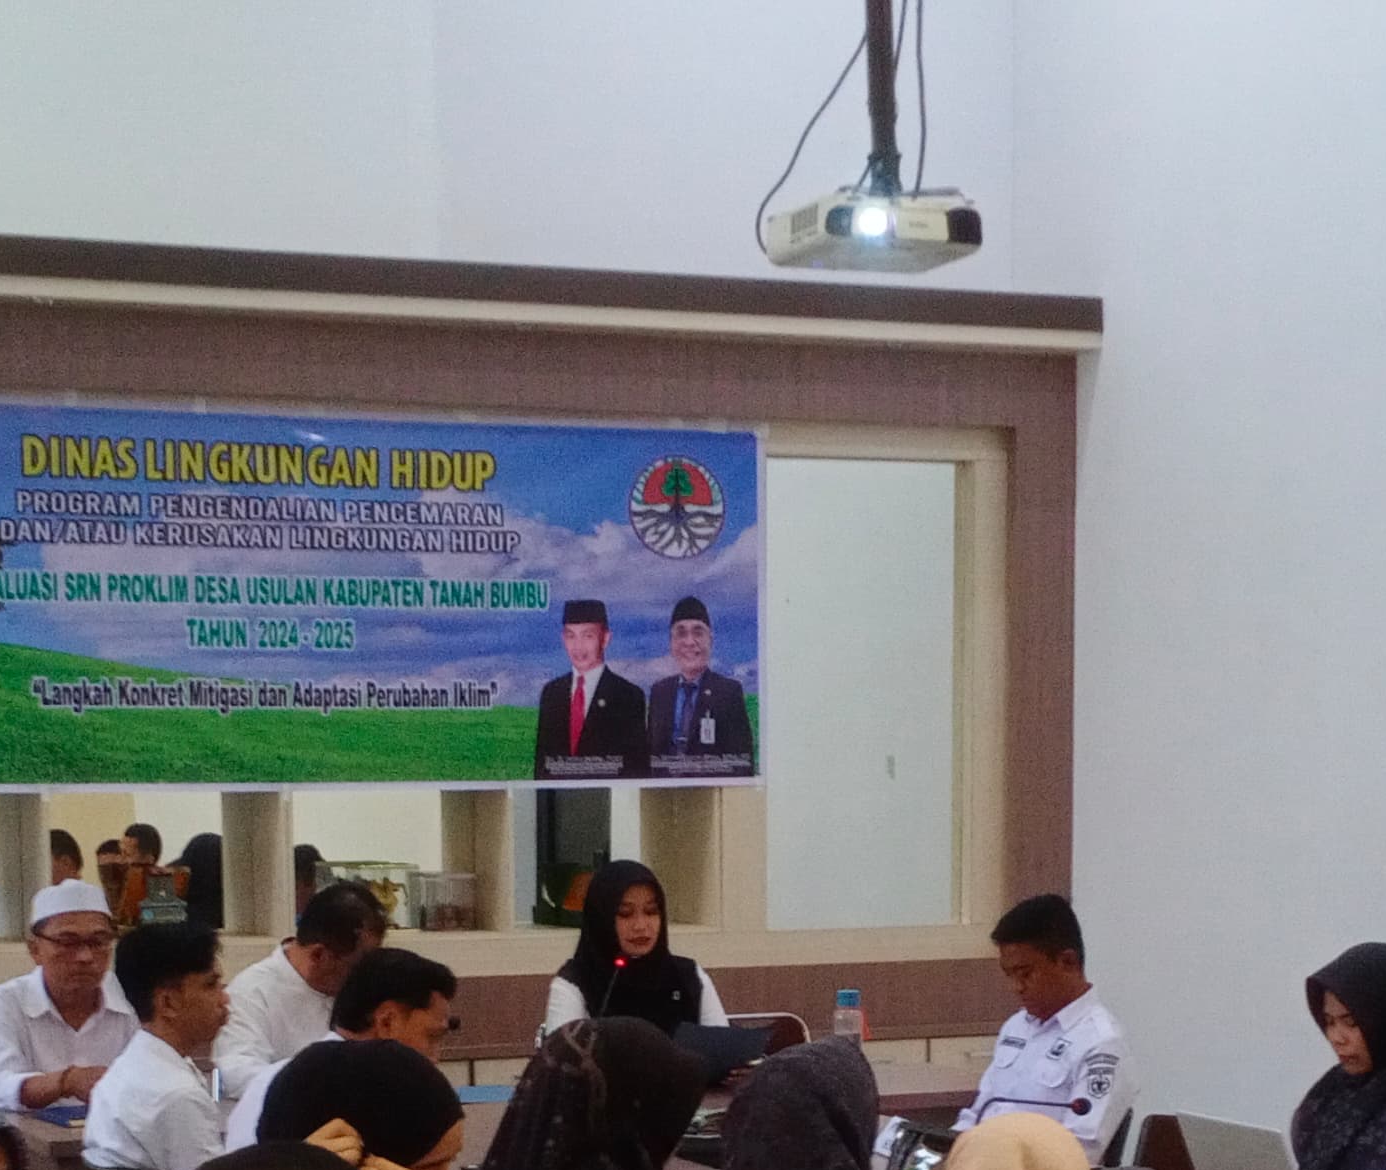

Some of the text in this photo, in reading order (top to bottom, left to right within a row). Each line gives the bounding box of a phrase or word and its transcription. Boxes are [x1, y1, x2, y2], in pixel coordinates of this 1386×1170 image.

[21, 434, 496, 491] DINAS LINGKUNGAN HIDUP
[16, 488, 504, 526] PROGRAM PENGENDALIAN PENCEMARAN
[0, 518, 520, 553] DAN/ATAU KERUSAKAN LINGKUNGAN HIDUP
[64, 572, 101, 601] SRN
[108, 574, 189, 602] PROKLIM
[194, 575, 241, 604] DESA
[246, 576, 317, 605] USULAN
[323, 578, 424, 607] KABUPATEN
[429, 580, 485, 608] TANAH
[490, 581, 548, 609] BUMBU
[186, 618, 247, 647] TAHUN
[258, 620, 299, 648] 2024
[314, 621, 354, 649] 2025
[117, 680, 184, 706] Konkret
[188, 680, 253, 714] Mitigasi
[258, 682, 288, 707] dan
[293, 682, 362, 714] Adaptasi
[366, 683, 449, 708] Perubahan
